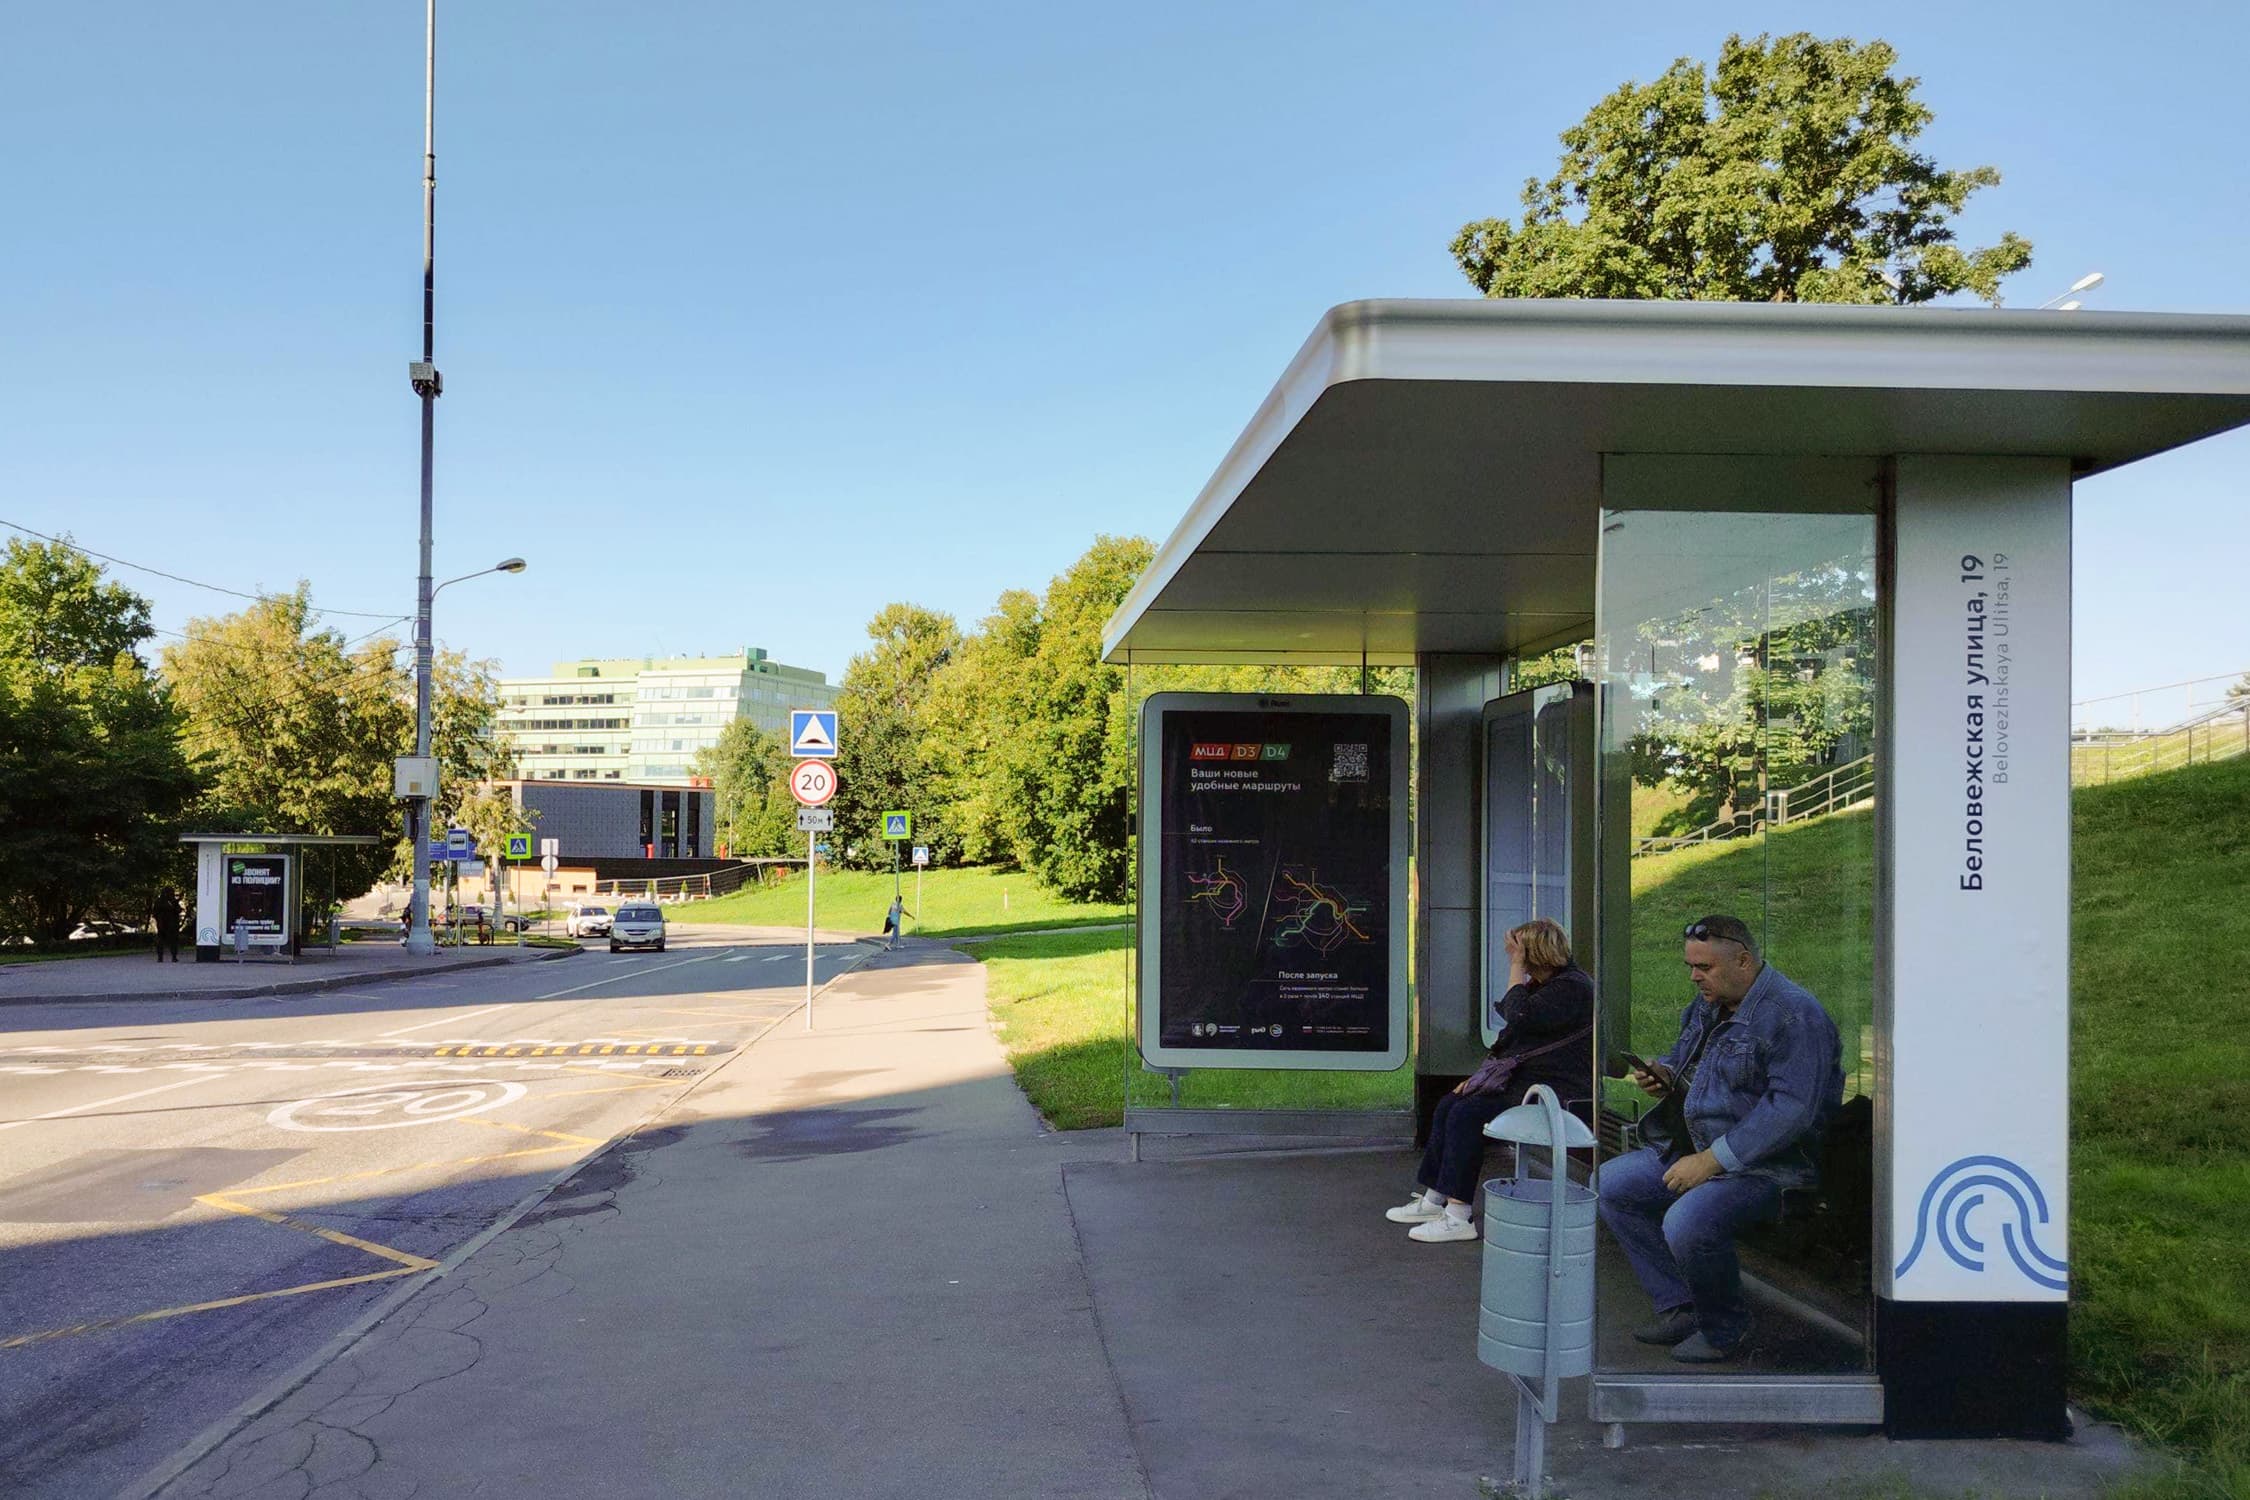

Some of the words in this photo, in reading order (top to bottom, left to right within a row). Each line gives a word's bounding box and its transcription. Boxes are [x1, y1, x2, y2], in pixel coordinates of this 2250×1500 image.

[1960, 554, 1984, 583] 19
[1993, 552, 2009, 573] 19
[1993, 576, 2012, 636] Ulitsa,
[1965, 591, 1989, 686] улица,
[1992, 643, 2012, 784] Belovezhskaya
[1194, 746, 1225, 757] МЦД
[1236, 746, 1256, 757] D3
[1265, 746, 1286, 757] D4
[801, 774, 826, 791] 20
[1191, 768, 1220, 778] Ваши
[1223, 770, 1259, 778] новые
[1190, 780, 1240, 792] удобные
[1242, 782, 1301, 793] маршруты
[1960, 694, 1983, 891] Беловежская
[1190, 824, 1213, 832] Было
[1278, 971, 1305, 979] После
